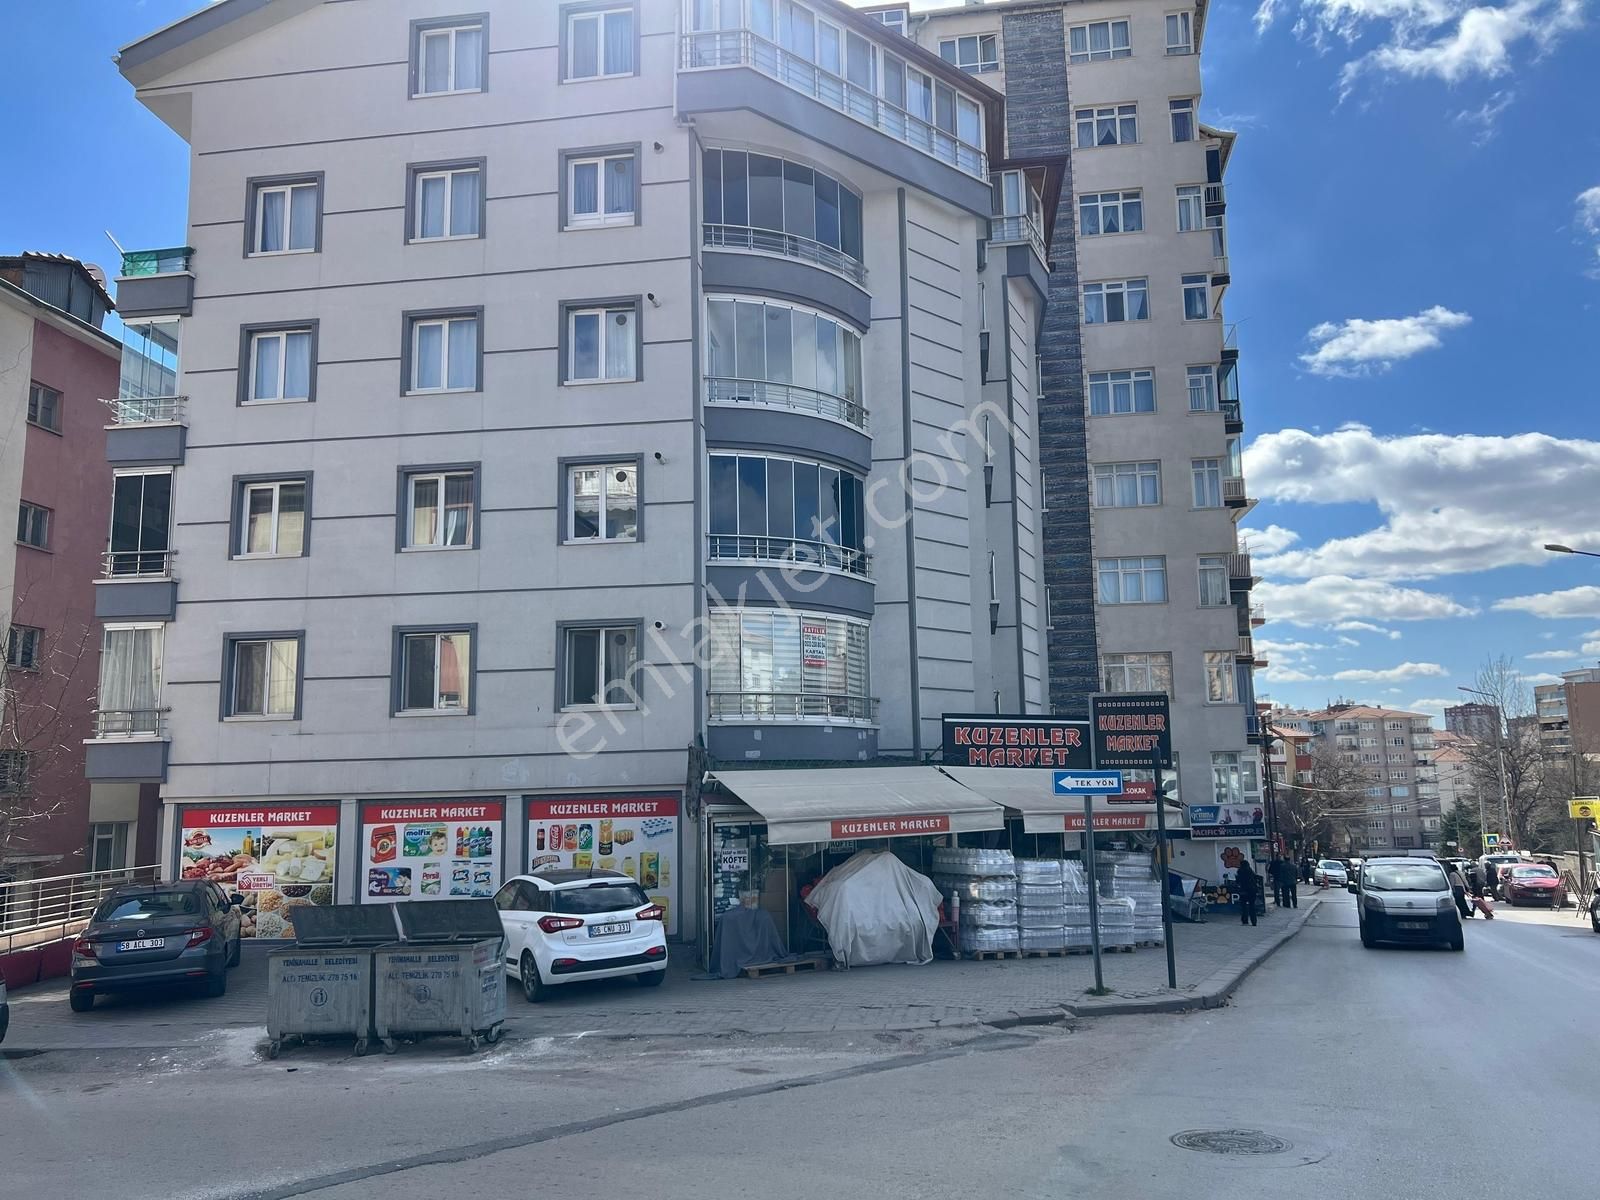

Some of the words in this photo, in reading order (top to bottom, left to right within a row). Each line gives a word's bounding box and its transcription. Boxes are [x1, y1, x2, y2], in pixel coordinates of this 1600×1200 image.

[1098, 713, 1166, 732] KUZENLER
[954, 727, 1082, 747] KUZENLER
[1106, 734, 1160, 752] MARKET
[968, 747, 1069, 767] MARKET
[1096, 778, 1115, 787] YÖN
[1126, 787, 1147, 795] SOKAK
[381, 808, 437, 819] KUZENLER
[440, 806, 486, 818] MARKET
[550, 803, 608, 815] KUZENLER
[612, 802, 658, 813] MARKET
[210, 812, 265, 824] KUZENLER
[268, 811, 312, 822] MARKET
[1071, 817, 1109, 827] KUZNLER
[1112, 817, 1140, 827] MARKET
[841, 821, 896, 834] KUZENLER
[900, 819, 942, 830] MARKET
[422, 871, 440, 880] Persil
[121, 942, 130, 950] 58
[134, 940, 146, 949] ACL
[150, 939, 163, 947] 303
